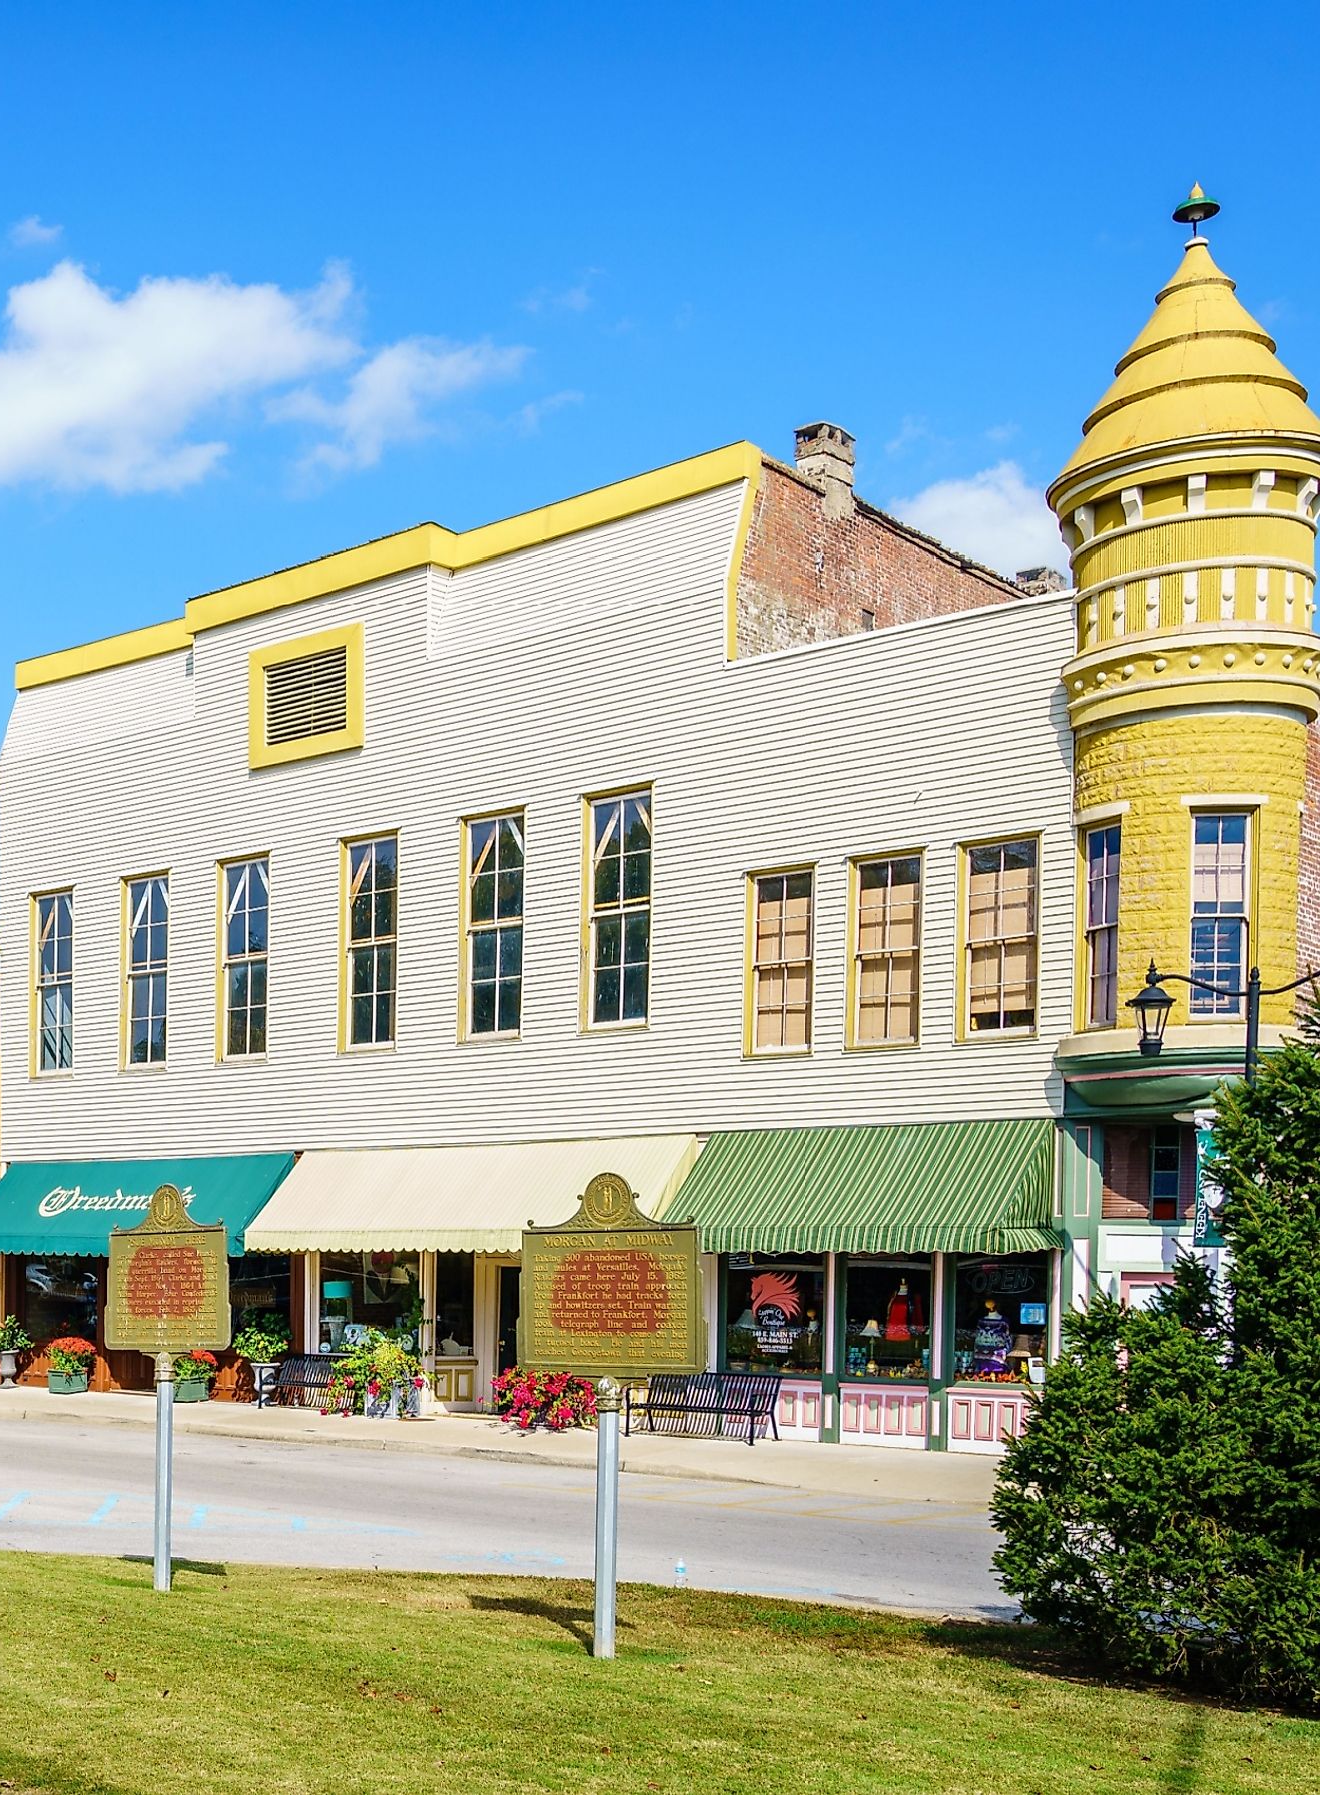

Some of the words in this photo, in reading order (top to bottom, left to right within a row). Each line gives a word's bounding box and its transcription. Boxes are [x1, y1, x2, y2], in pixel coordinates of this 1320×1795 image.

[544, 1236, 596, 1248] MORGAN
[603, 1235, 618, 1247] AT
[626, 1233, 674, 1247] MIDWAY
[584, 1253, 630, 1262] abandoned
[635, 1253, 654, 1261] USA
[555, 1262, 577, 1271] mules
[582, 1263, 591, 1271] at
[648, 1261, 688, 1272] Morgan's
[533, 1273, 565, 1281] Raiders
[596, 1272, 616, 1281] here
[621, 1272, 640, 1283] July
[971, 1268, 1030, 1293] OPEN
[534, 1282, 566, 1290] Advised
[572, 1282, 581, 1290] of
[588, 1282, 611, 1291] troop
[618, 1282, 640, 1290] train
[646, 1282, 688, 1291] approach
[534, 1291, 554, 1300] from
[558, 1290, 599, 1300] Frankfort
[602, 1291, 613, 1299] he
[616, 1290, 632, 1299] had
[636, 1290, 664, 1299] tracks
[668, 1291, 688, 1300] torn
[534, 1301, 544, 1311] up
[548, 1301, 562, 1310] and
[565, 1301, 605, 1310] howitzers
[608, 1301, 624, 1310] set.
[629, 1300, 652, 1310] Train
[655, 1301, 688, 1310] warned
[551, 1311, 588, 1319] returned
[591, 1311, 600, 1319] to
[602, 1310, 648, 1319] Frankfort.
[653, 1310, 688, 1320] Morgan
[534, 1320, 553, 1328] took
[560, 1320, 599, 1330] telegraph
[607, 1320, 624, 1329] line
[631, 1320, 648, 1329] and
[655, 1320, 688, 1329] coaxed
[570, 1330, 613, 1339] Lexington
[616, 1330, 626, 1338] to
[629, 1330, 651, 1338] come
[672, 1330, 688, 1338] but
[546, 1339, 575, 1348] turned
[629, 1339, 644, 1348] and
[669, 1341, 688, 1349] men
[534, 1348, 566, 1356] reached
[571, 1349, 621, 1359] Georgetown
[629, 1349, 645, 1357] that
